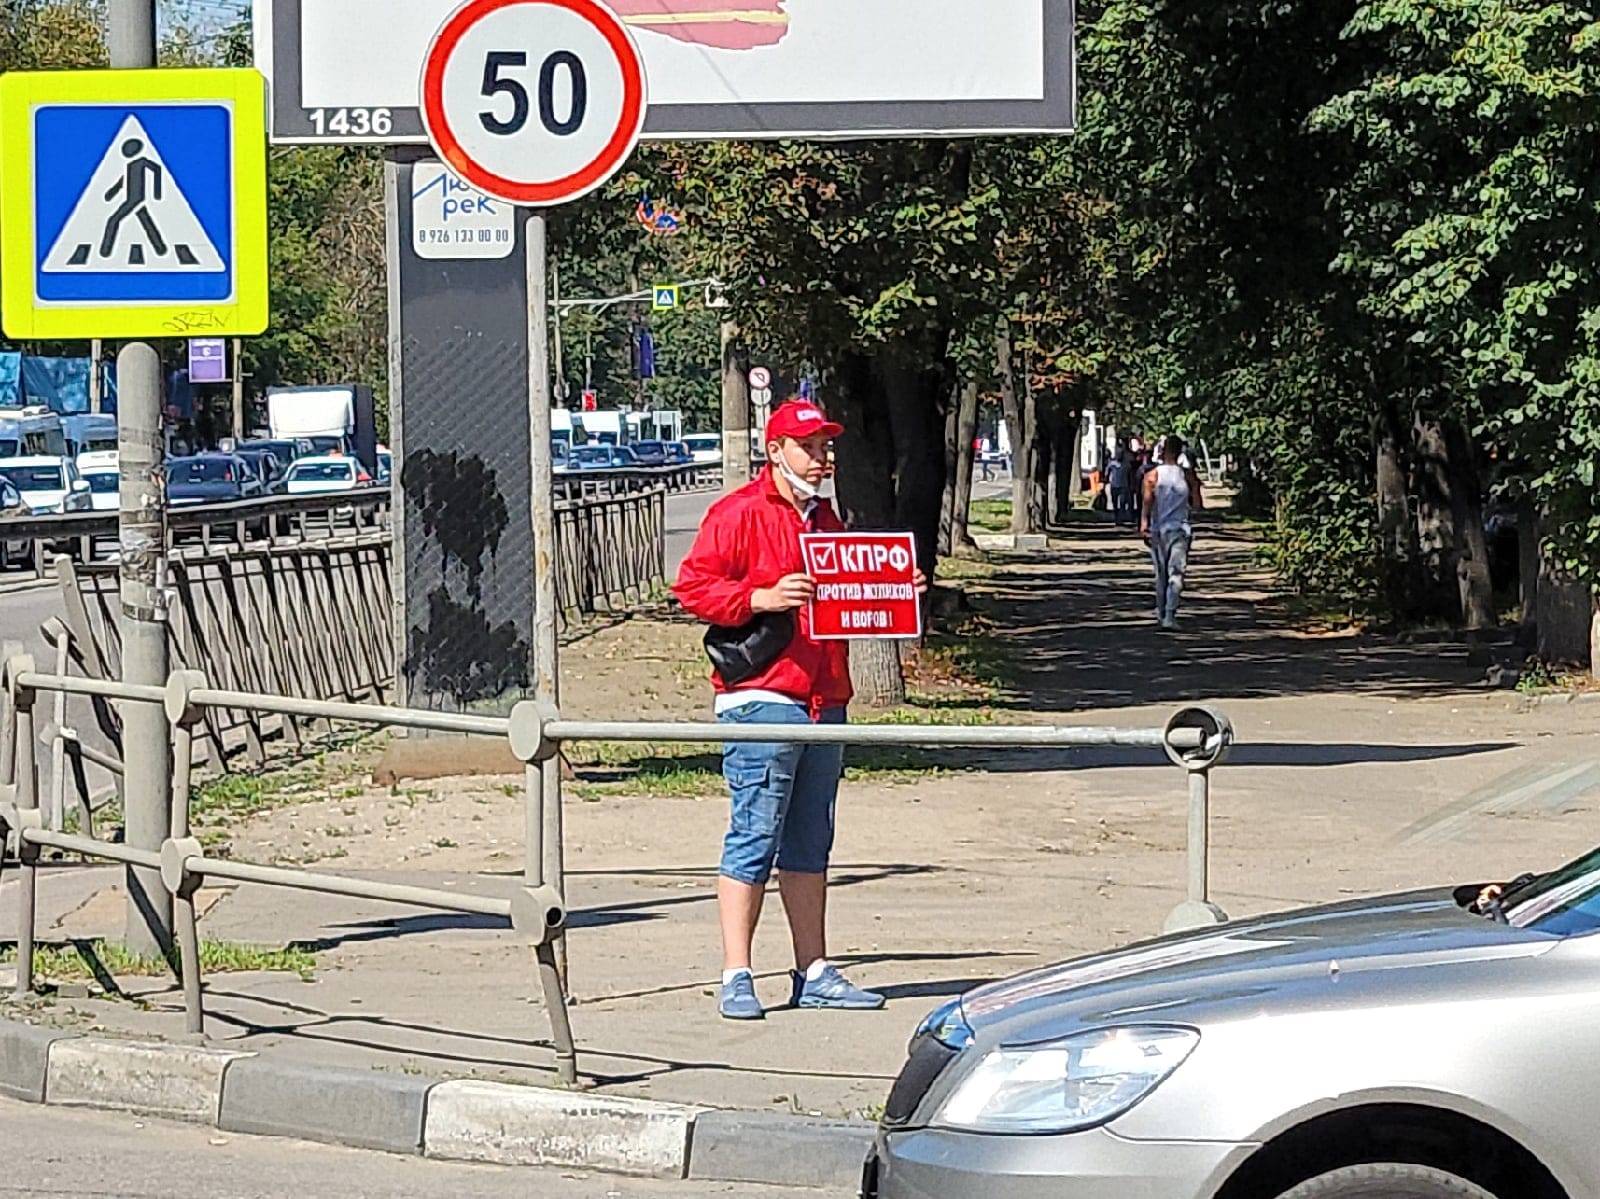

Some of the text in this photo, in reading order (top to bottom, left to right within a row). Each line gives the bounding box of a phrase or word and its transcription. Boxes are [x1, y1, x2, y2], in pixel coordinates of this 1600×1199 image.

[479, 50, 588, 136] 50
[309, 107, 393, 135] 1436
[429, 229, 450, 243] 926
[455, 229, 474, 243] 133
[478, 229, 492, 242] 00
[495, 229, 509, 242] 00
[839, 543, 910, 573] КПРФ
[816, 583, 914, 601] ПРОТИВ ЖУЛИКОВ
[840, 610, 850, 628] И
